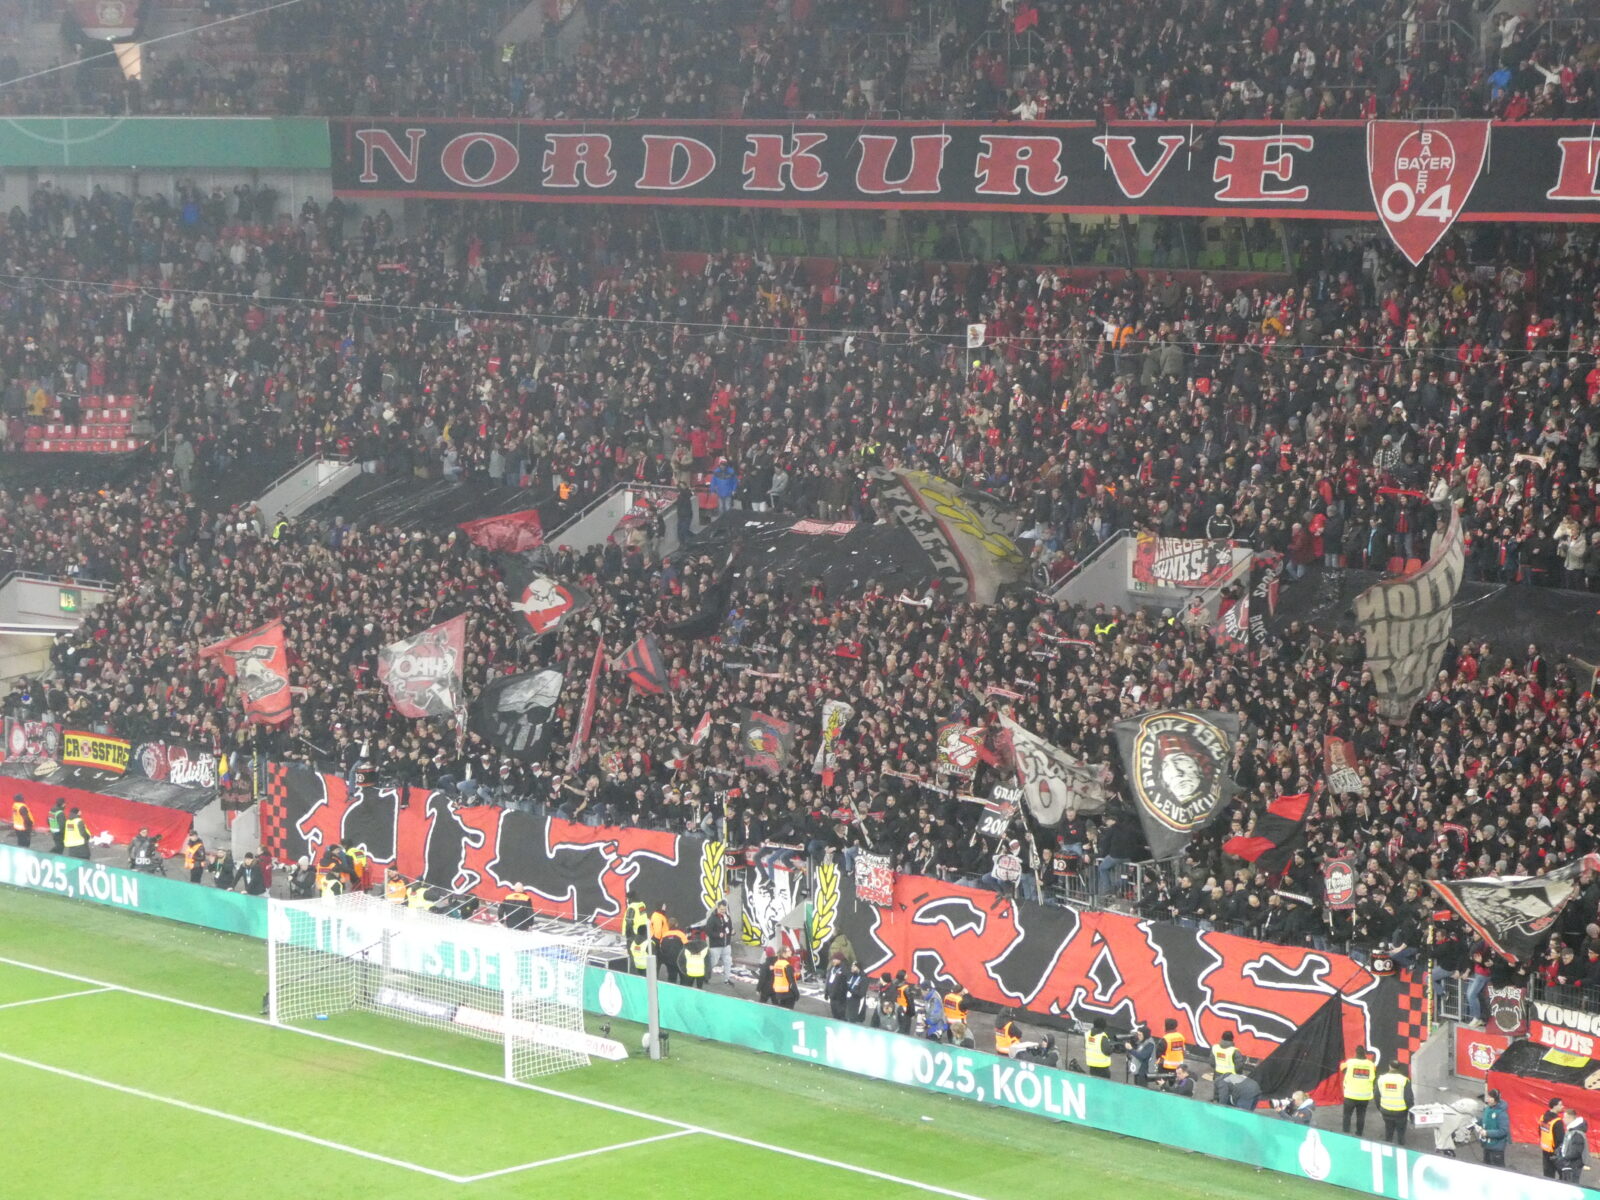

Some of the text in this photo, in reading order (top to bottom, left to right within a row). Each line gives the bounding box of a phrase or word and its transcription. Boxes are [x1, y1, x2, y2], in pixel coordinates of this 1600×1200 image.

[355, 128, 1314, 202] NORDKURVE
[1397, 155, 1452, 171] BAYER
[1381, 181, 1453, 224] 04
[65, 737, 130, 767] CROSSFIRE
[78, 863, 139, 908] KÖLN
[1540, 1024, 1595, 1056] BOYS
[791, 1020, 818, 1059] 1.
[992, 1060, 1087, 1120] KÖLN
